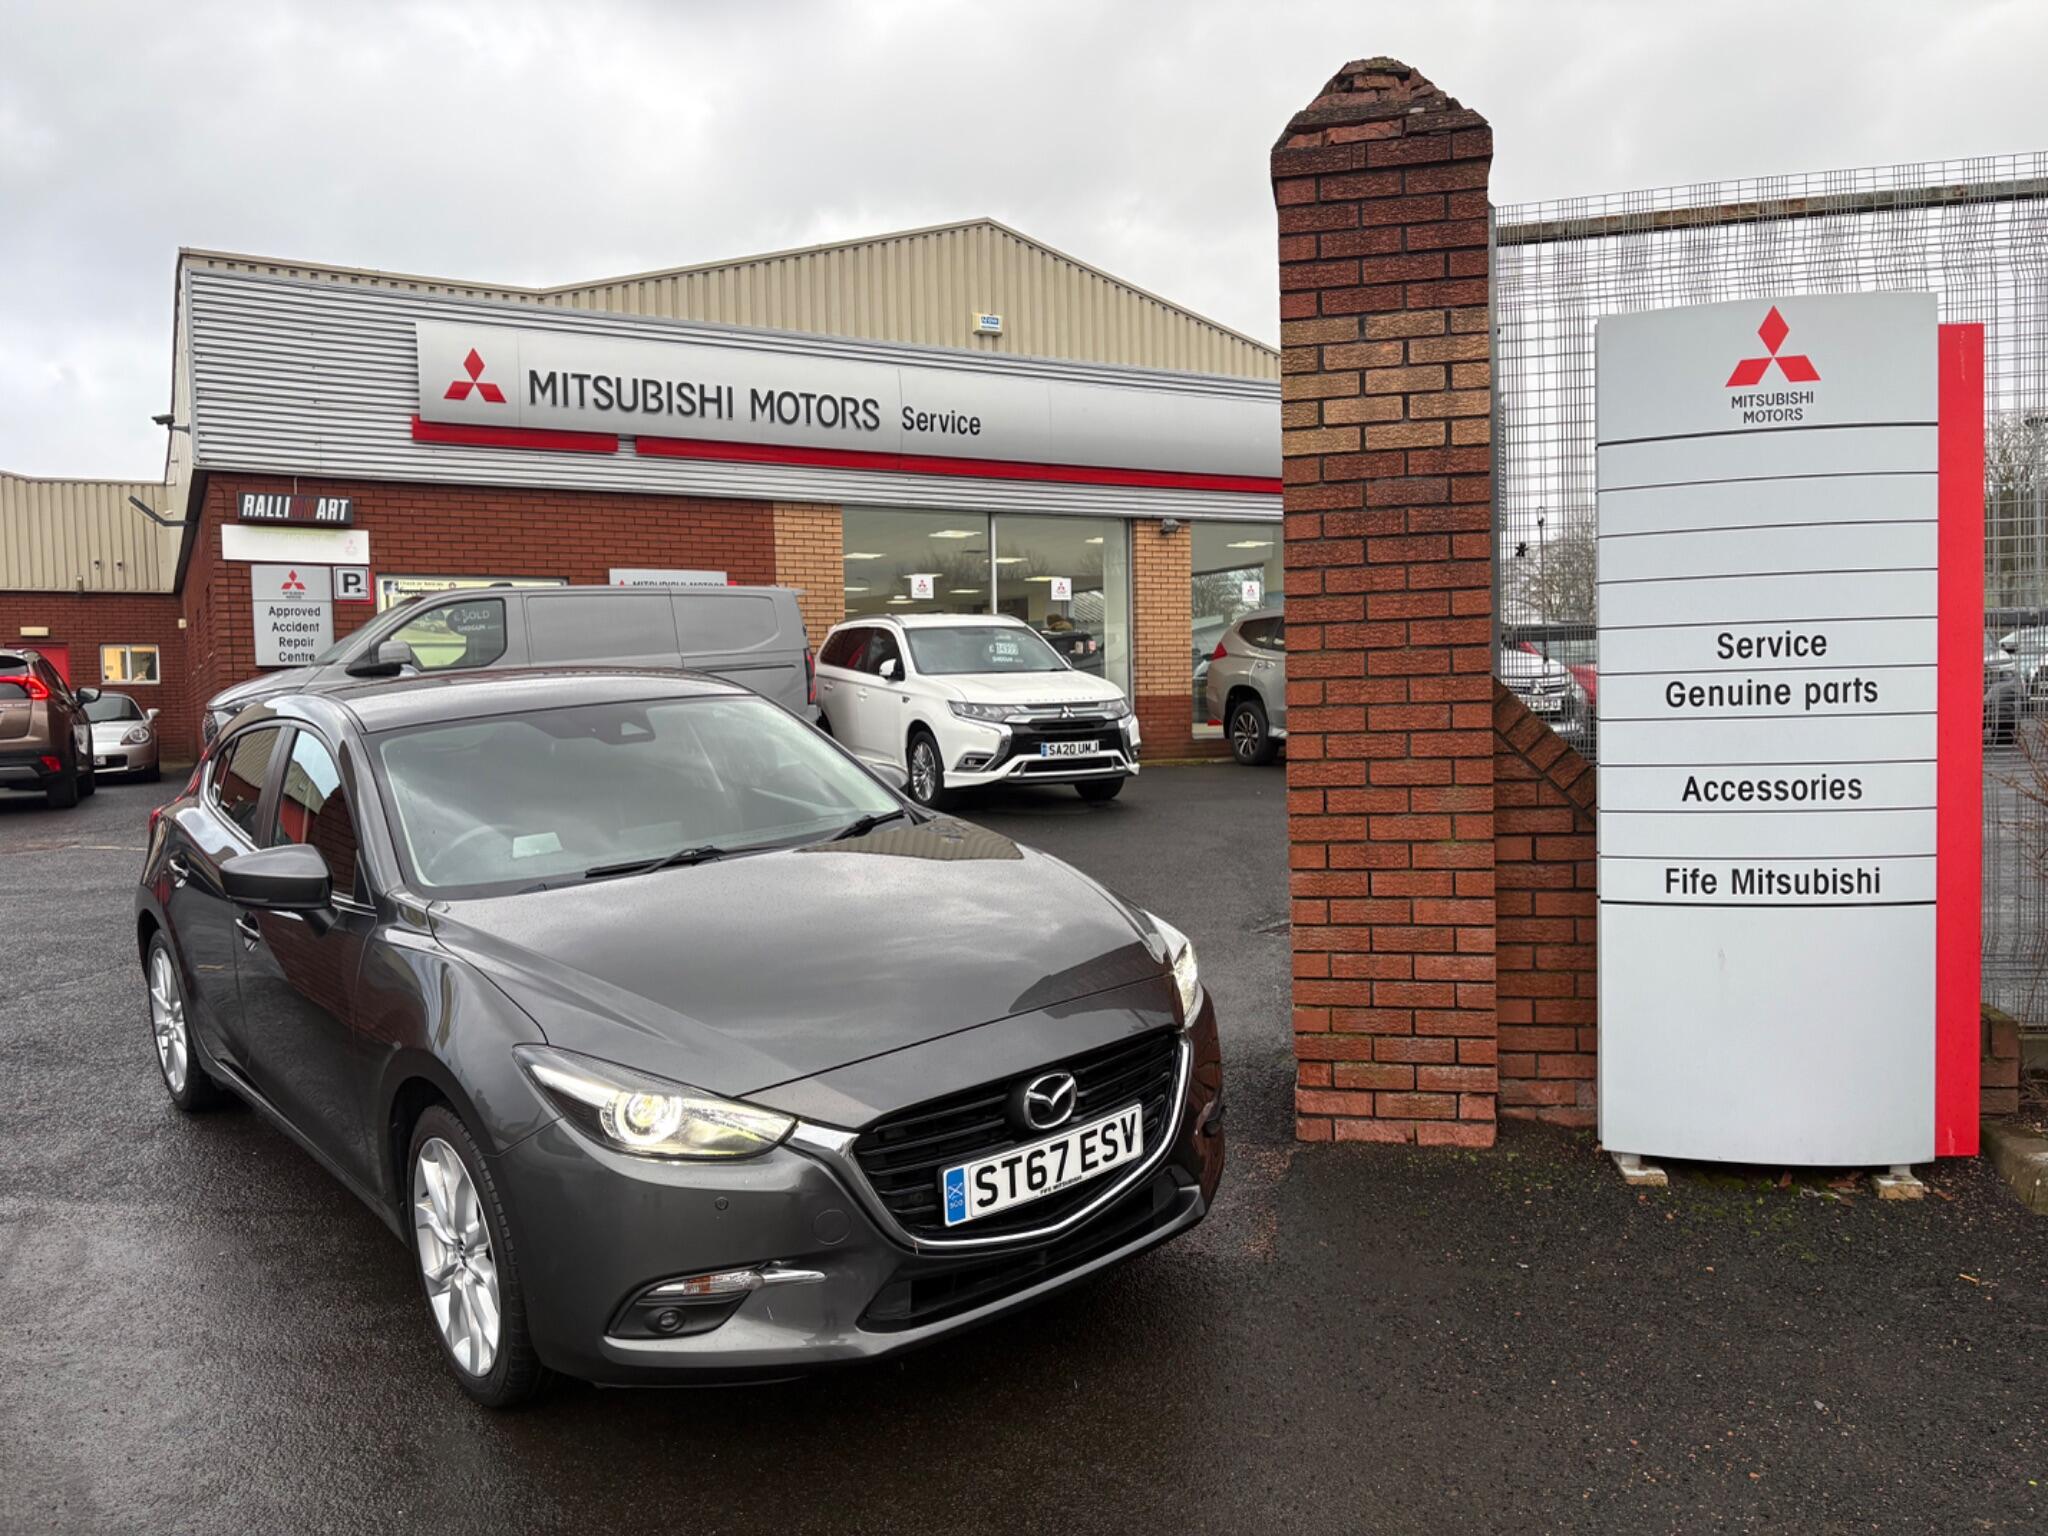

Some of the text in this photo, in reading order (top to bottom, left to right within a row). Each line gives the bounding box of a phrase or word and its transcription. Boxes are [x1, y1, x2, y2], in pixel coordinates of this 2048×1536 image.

[529, 369, 880, 431] MITSUBISHI MOTORS
[1731, 391, 1814, 409] MITSUBISHI
[901, 405, 981, 436] Service
[1743, 407, 1803, 424] MOTORS
[242, 494, 349, 521] RALLI ART
[342, 573, 361, 593] P
[268, 606, 321, 618] Approved
[272, 622, 319, 632] Accident
[278, 637, 314, 649] Repair
[1717, 630, 1827, 659] Service
[278, 652, 316, 662] Centre
[1665, 677, 1878, 711] Genuine parts
[1682, 774, 1863, 802] Accessories
[1665, 867, 1881, 896] Fife Mitsubishi
[975, 1112, 1136, 1208] ST67 ESV
